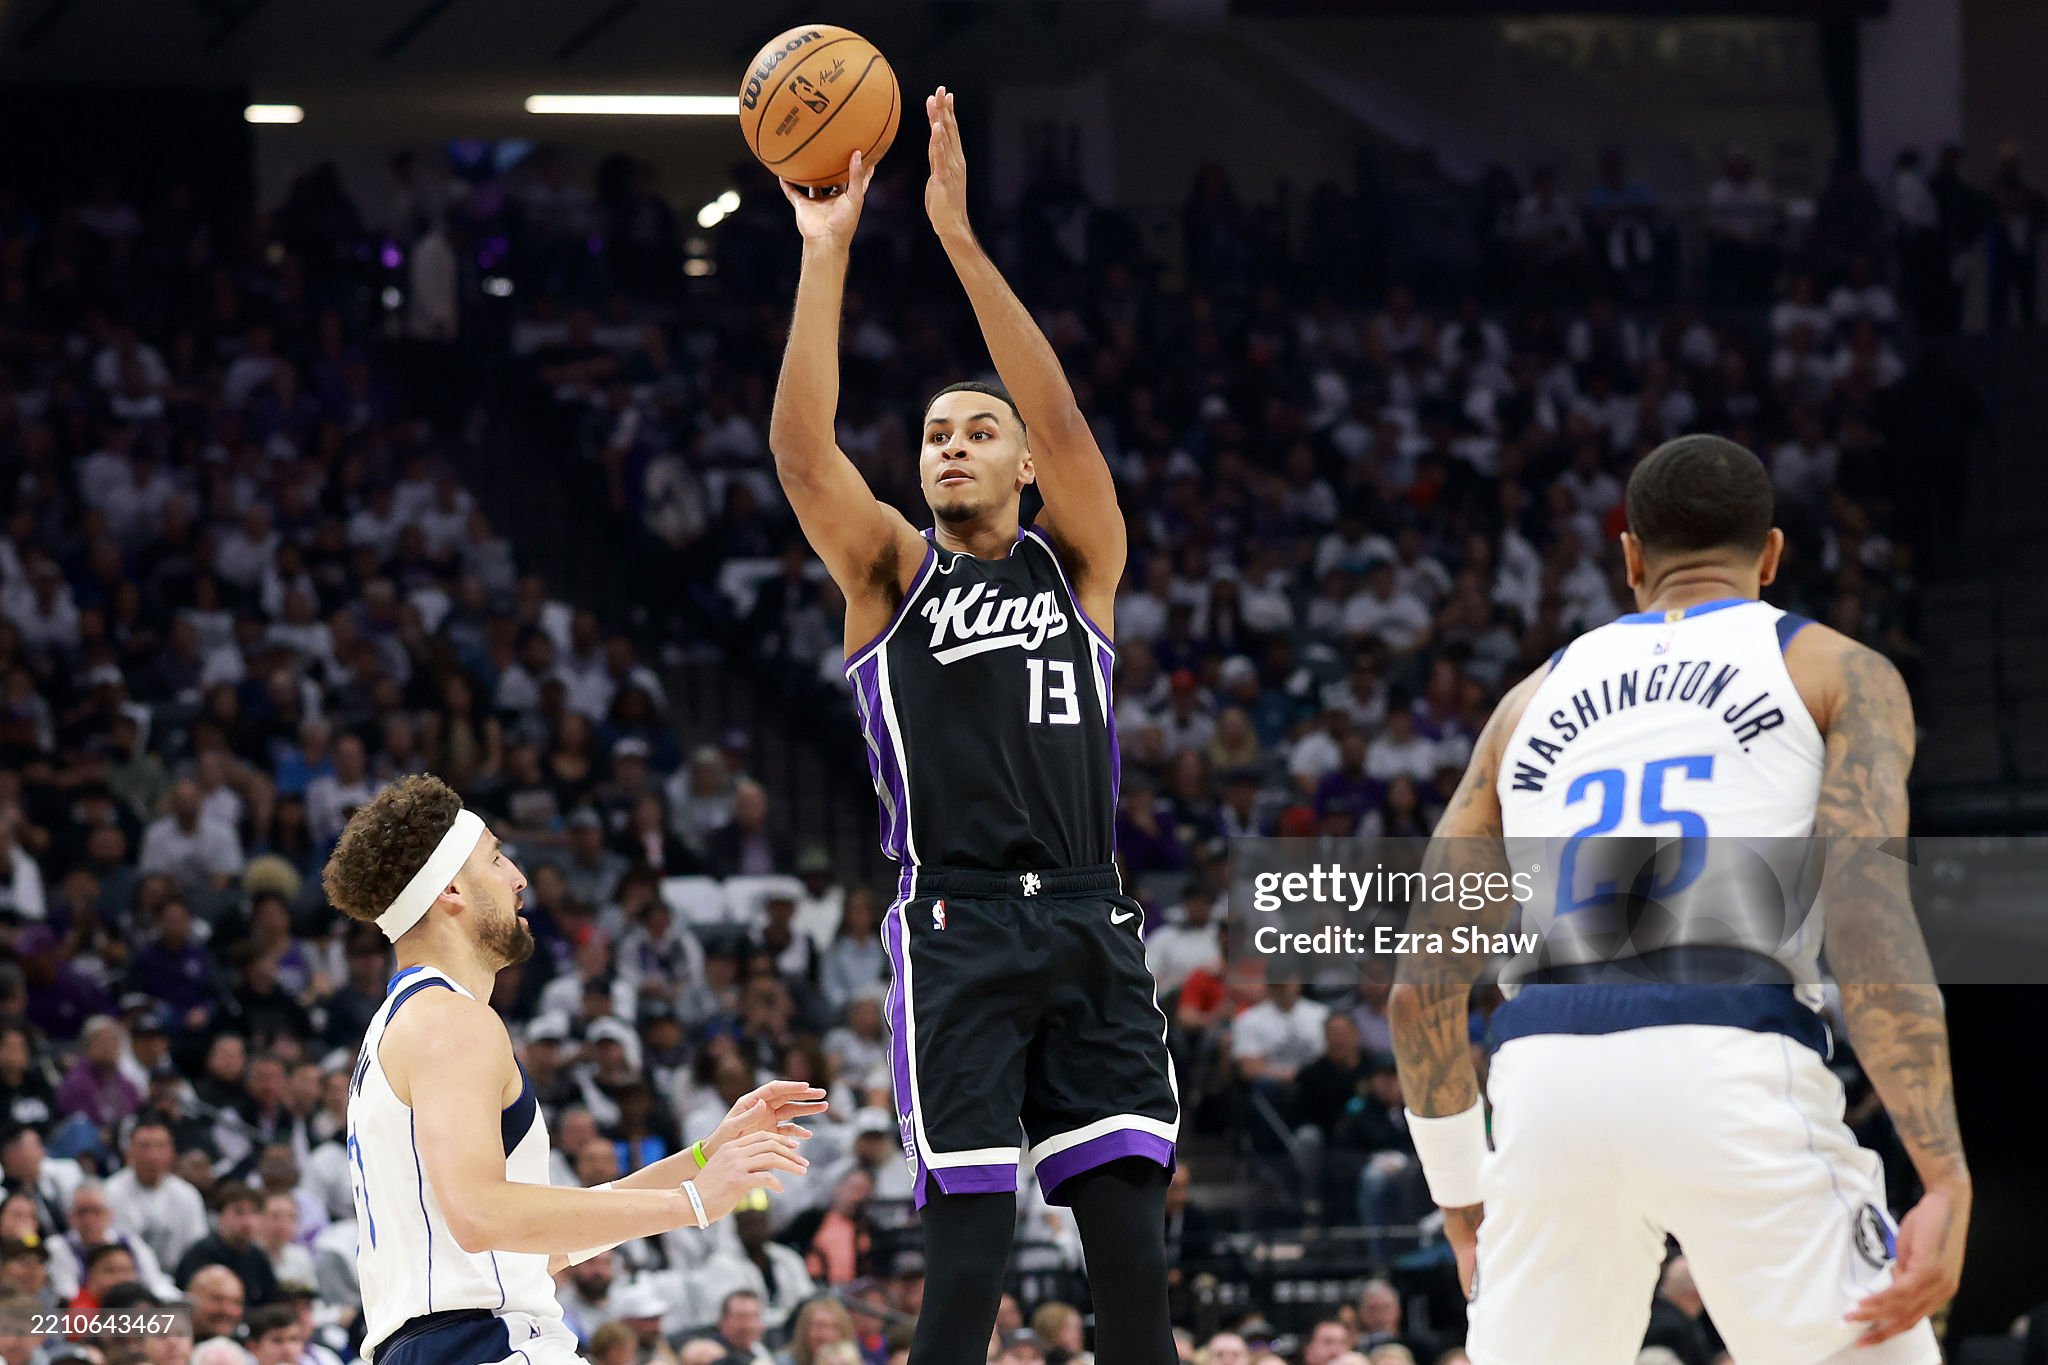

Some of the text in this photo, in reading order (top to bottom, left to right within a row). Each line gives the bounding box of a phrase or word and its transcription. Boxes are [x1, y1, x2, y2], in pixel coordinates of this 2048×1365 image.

[742, 31, 822, 110] Wilson
[920, 582, 1068, 665] Kings
[1026, 658, 1081, 725] 13
[1512, 660, 1785, 792] WASHINGTON JR.
[1554, 754, 1715, 918] 25
